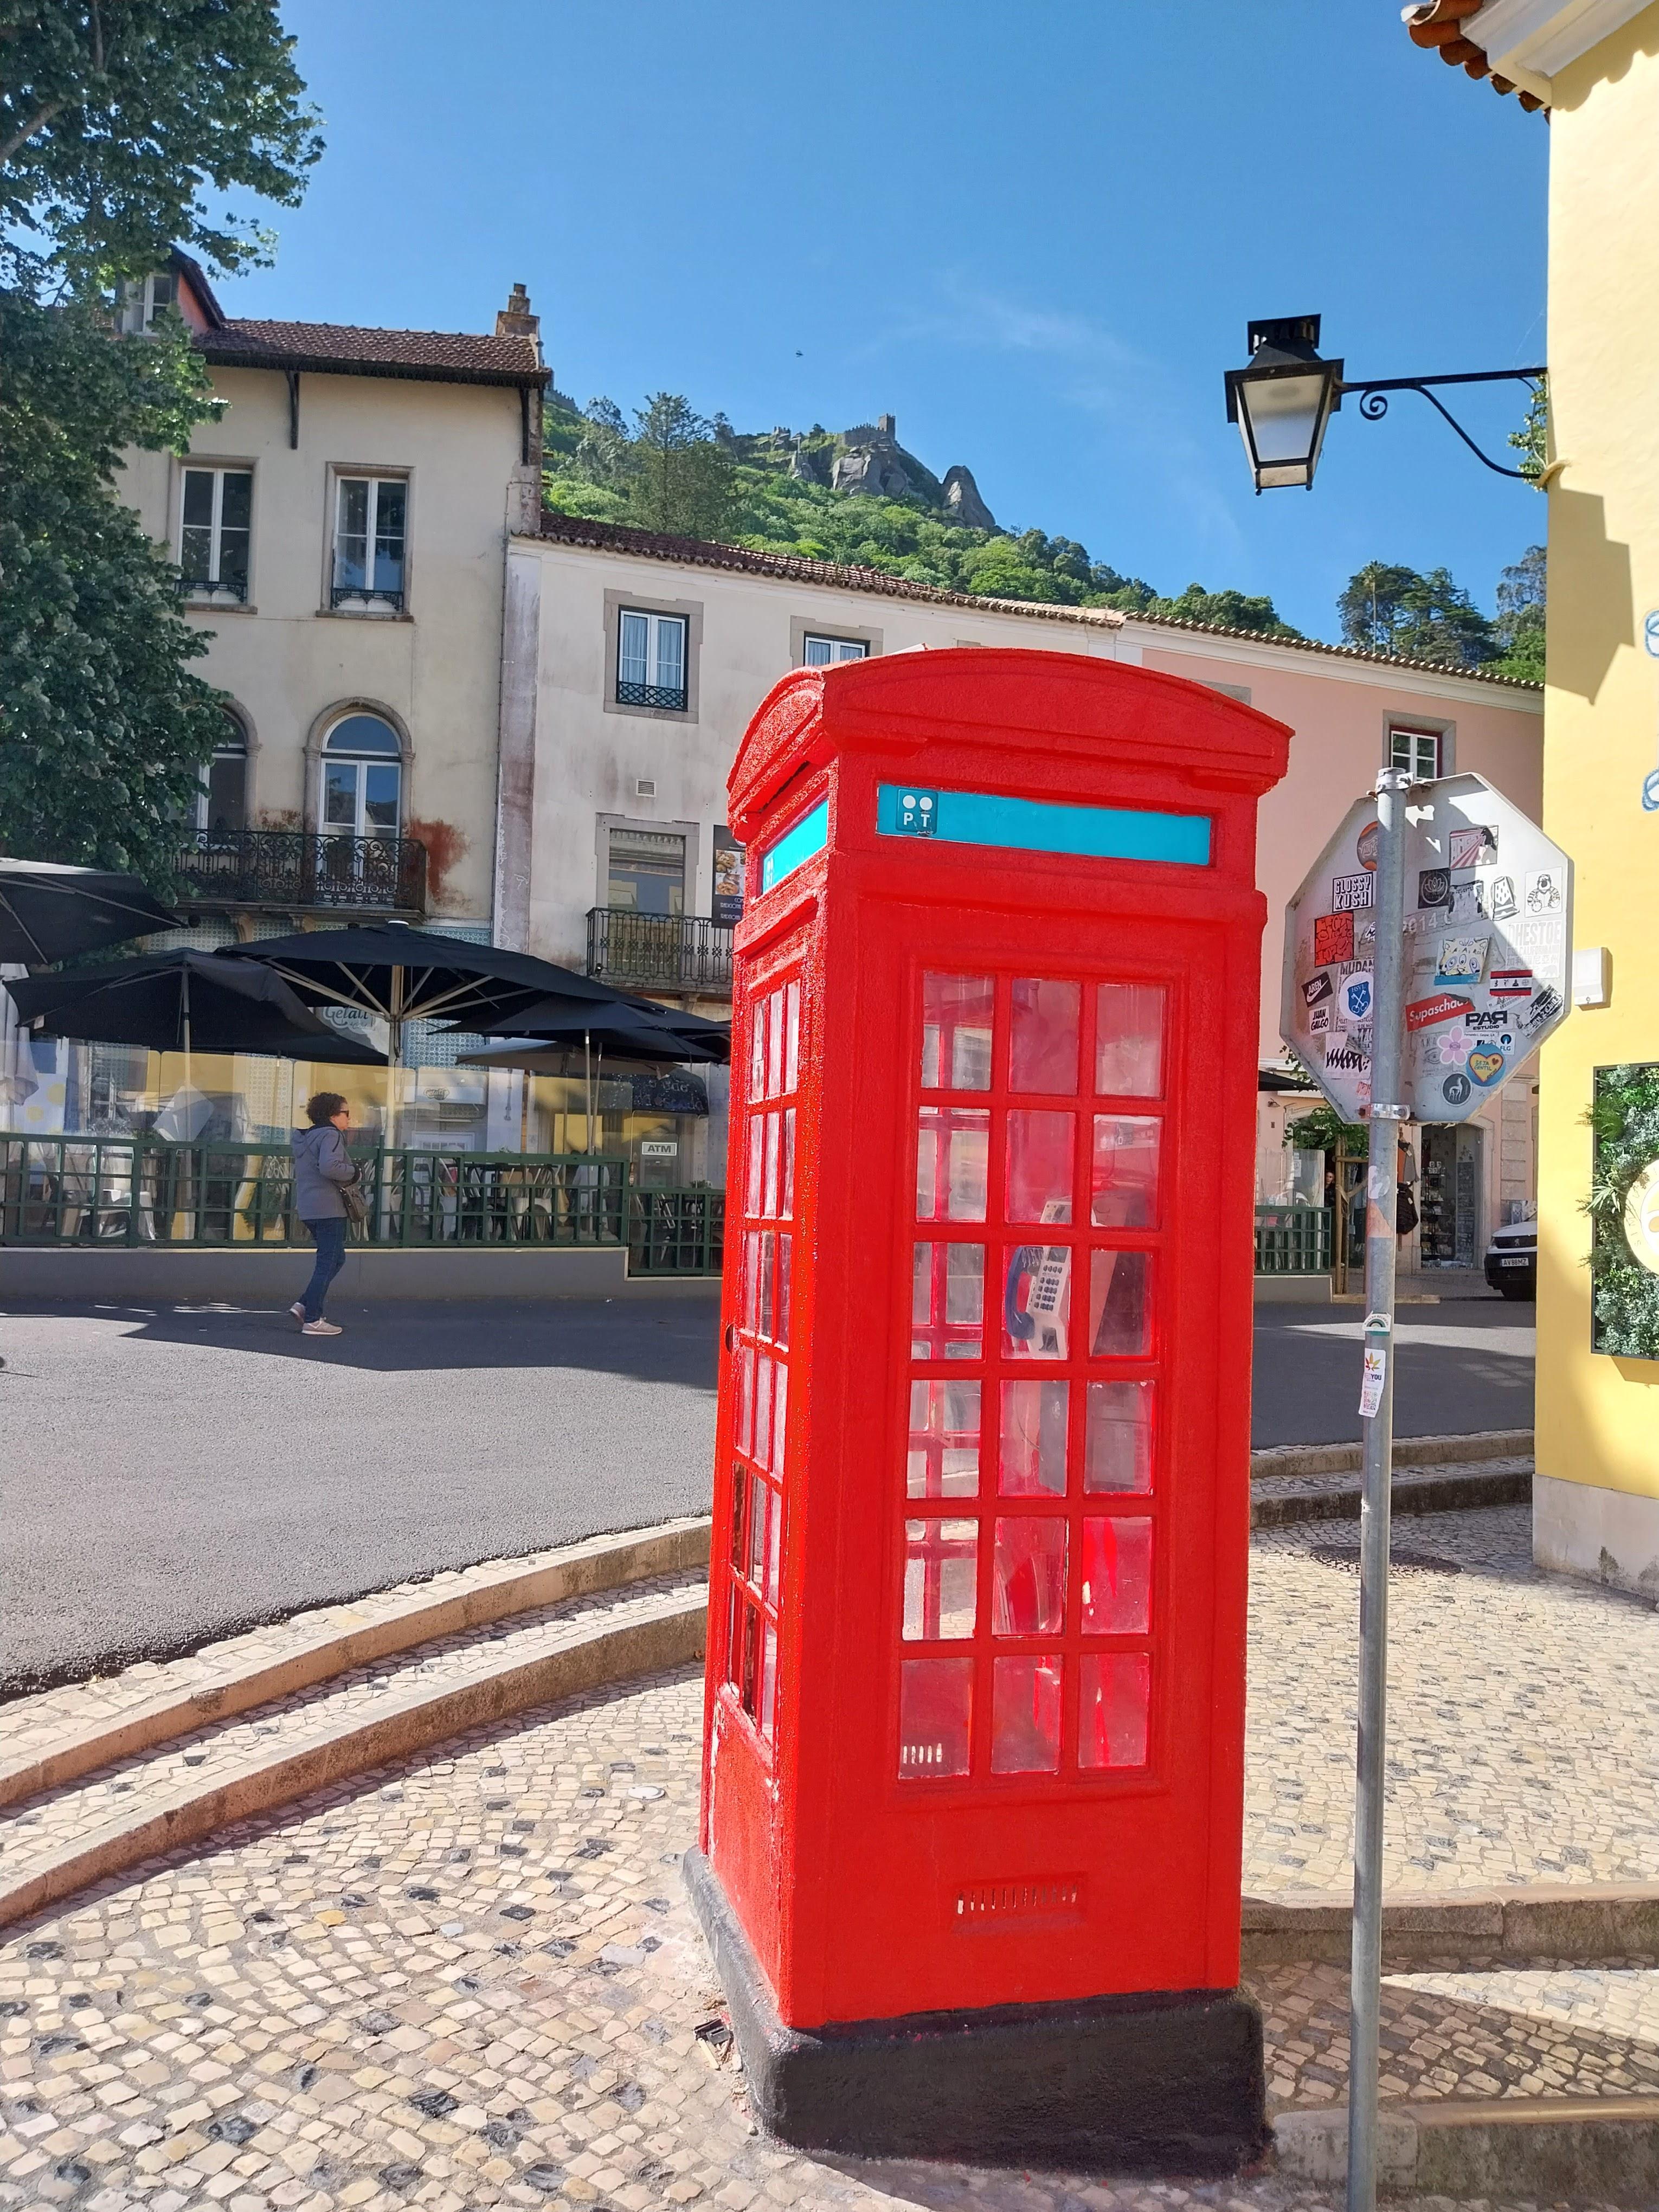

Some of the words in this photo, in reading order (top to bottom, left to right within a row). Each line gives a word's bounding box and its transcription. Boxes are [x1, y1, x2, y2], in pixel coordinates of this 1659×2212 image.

[1335, 876, 1371, 894] GLOSSY
[1335, 891, 1369, 910] KUSH
[1308, 979, 1322, 995] AREN
[1313, 1008, 1326, 1020] JUAN
[1311, 1018, 1329, 1031] GALGO
